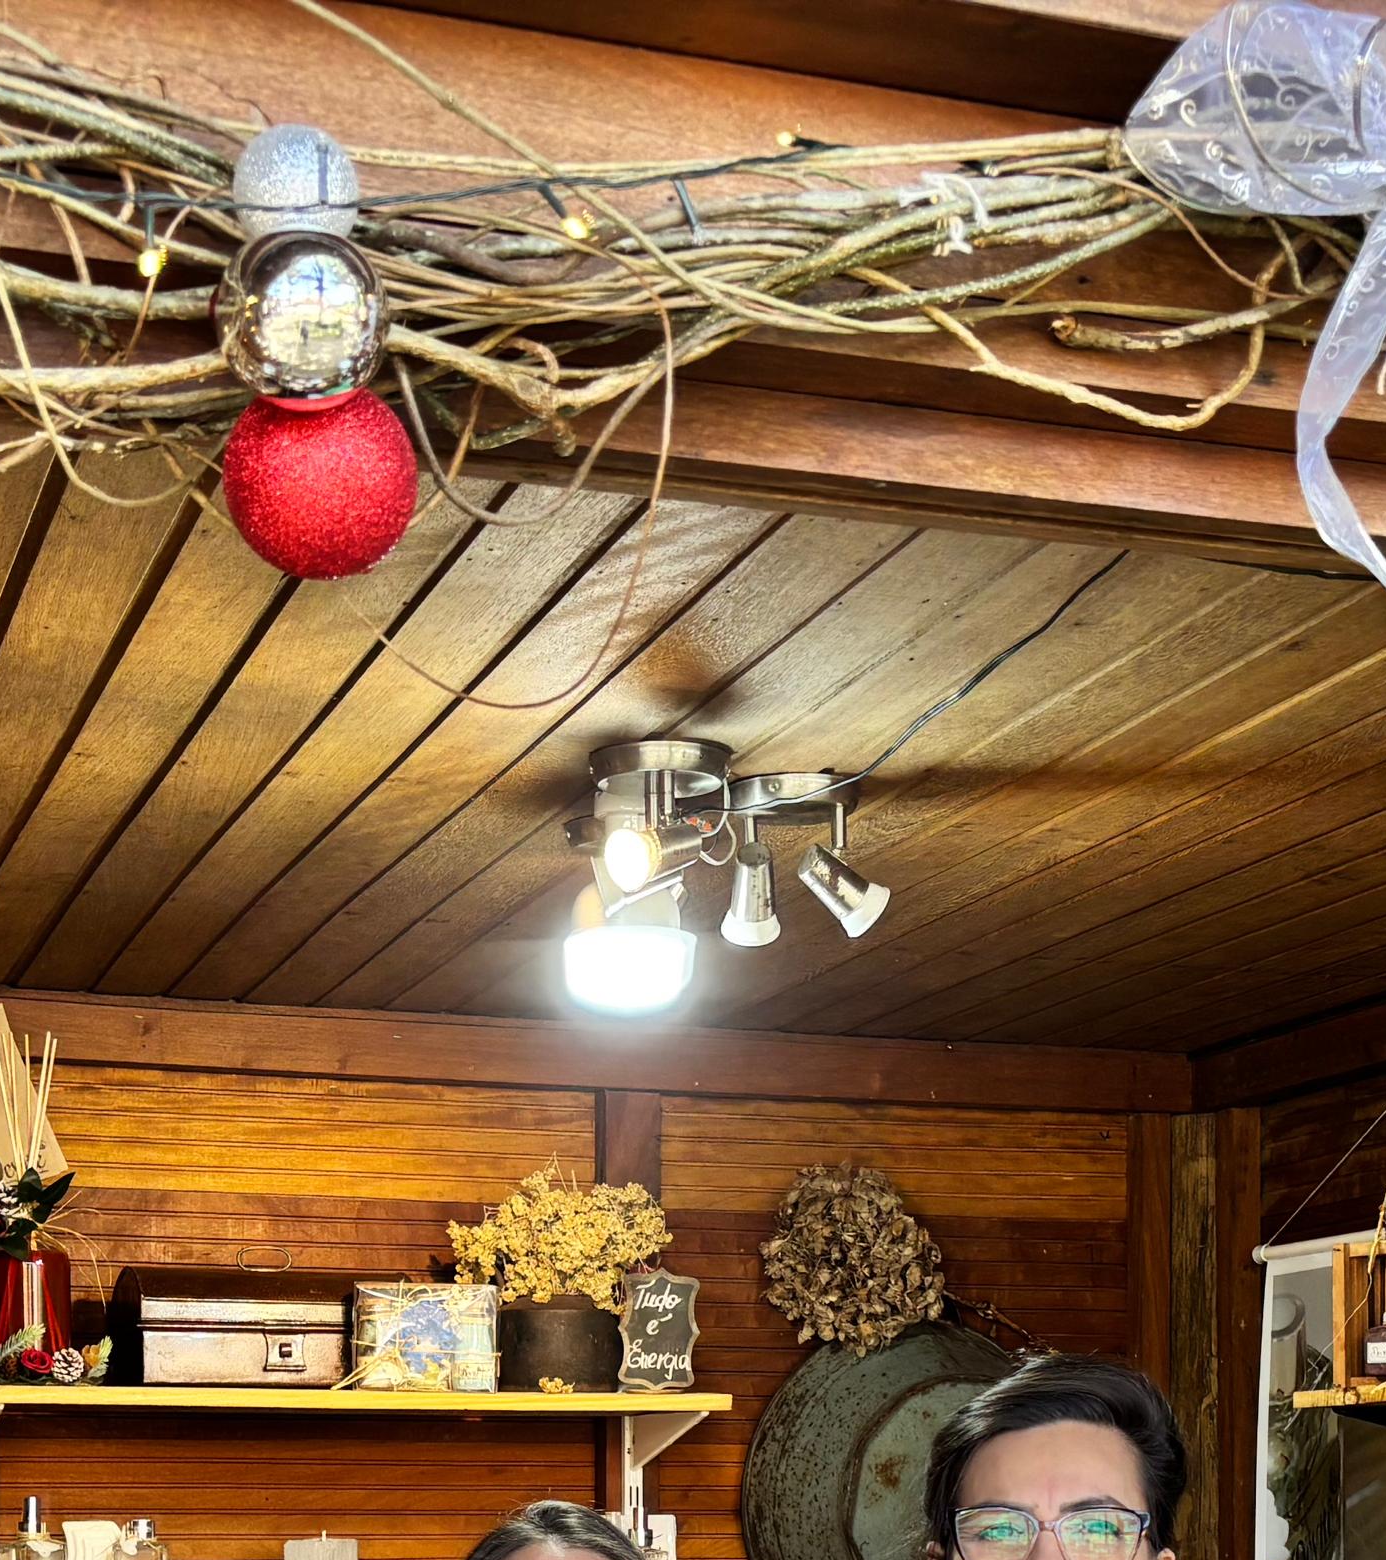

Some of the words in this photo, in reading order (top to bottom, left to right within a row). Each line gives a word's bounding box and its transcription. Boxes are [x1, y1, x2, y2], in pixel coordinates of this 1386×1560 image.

[634, 1279, 682, 1312] Tudo
[646, 1313, 673, 1335] é
[628, 1339, 692, 1380] Energia
